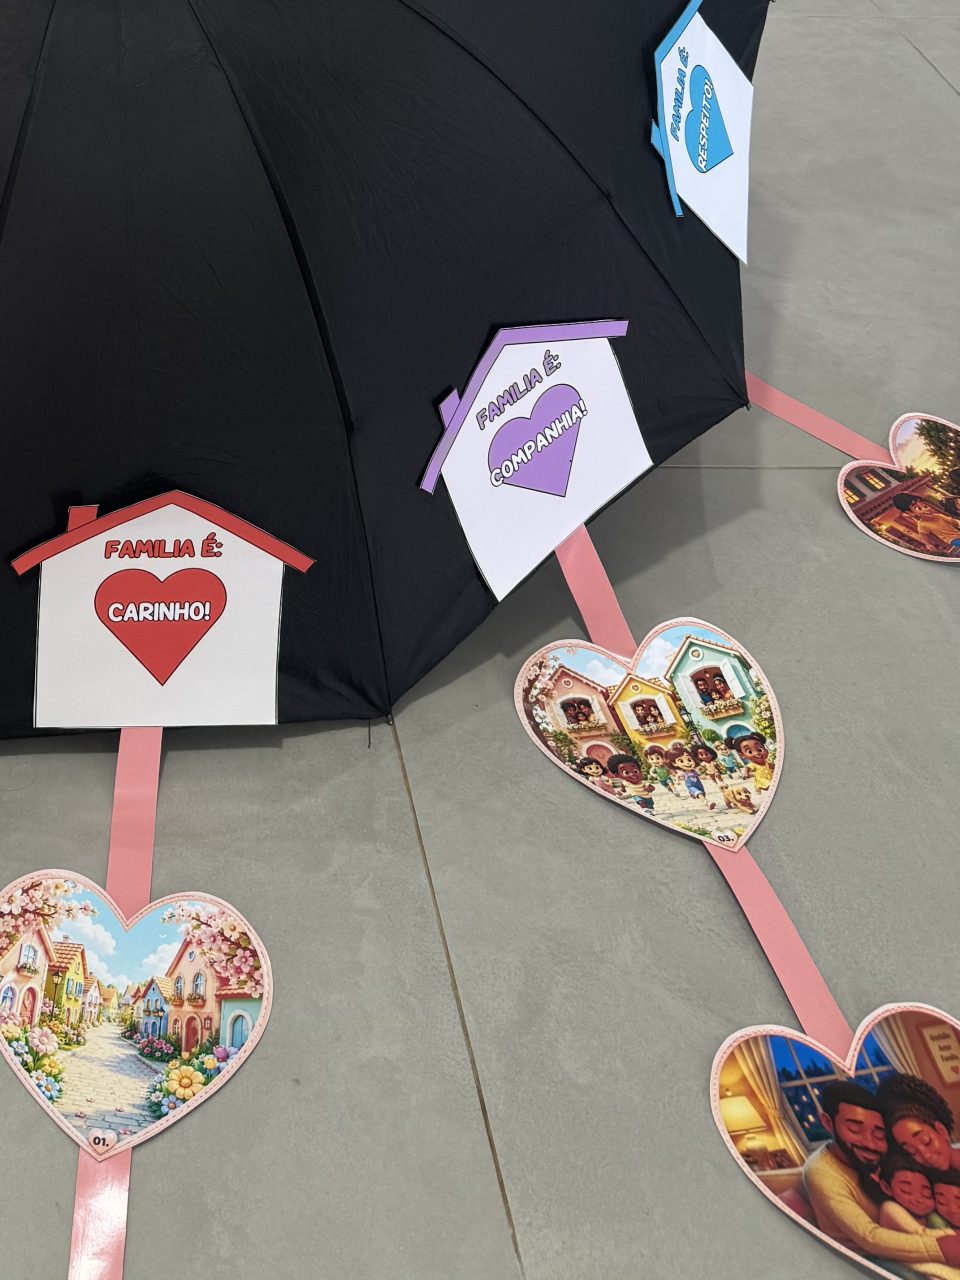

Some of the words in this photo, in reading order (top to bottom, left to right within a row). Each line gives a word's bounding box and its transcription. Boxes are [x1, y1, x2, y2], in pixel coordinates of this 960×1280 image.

[669, 67, 689, 143] FAMILIA
[696, 77, 715, 172] RESPEITO!
[475, 367, 543, 430] FAMILIA
[489, 399, 589, 487] COMPANHIA!
[104, 539, 195, 559] FAMILIA
[200, 532, 224, 558] É:
[107, 600, 212, 622] CARINHO!
[717, 834, 735, 842] 03.
[92, 1136, 110, 1147] 01.
